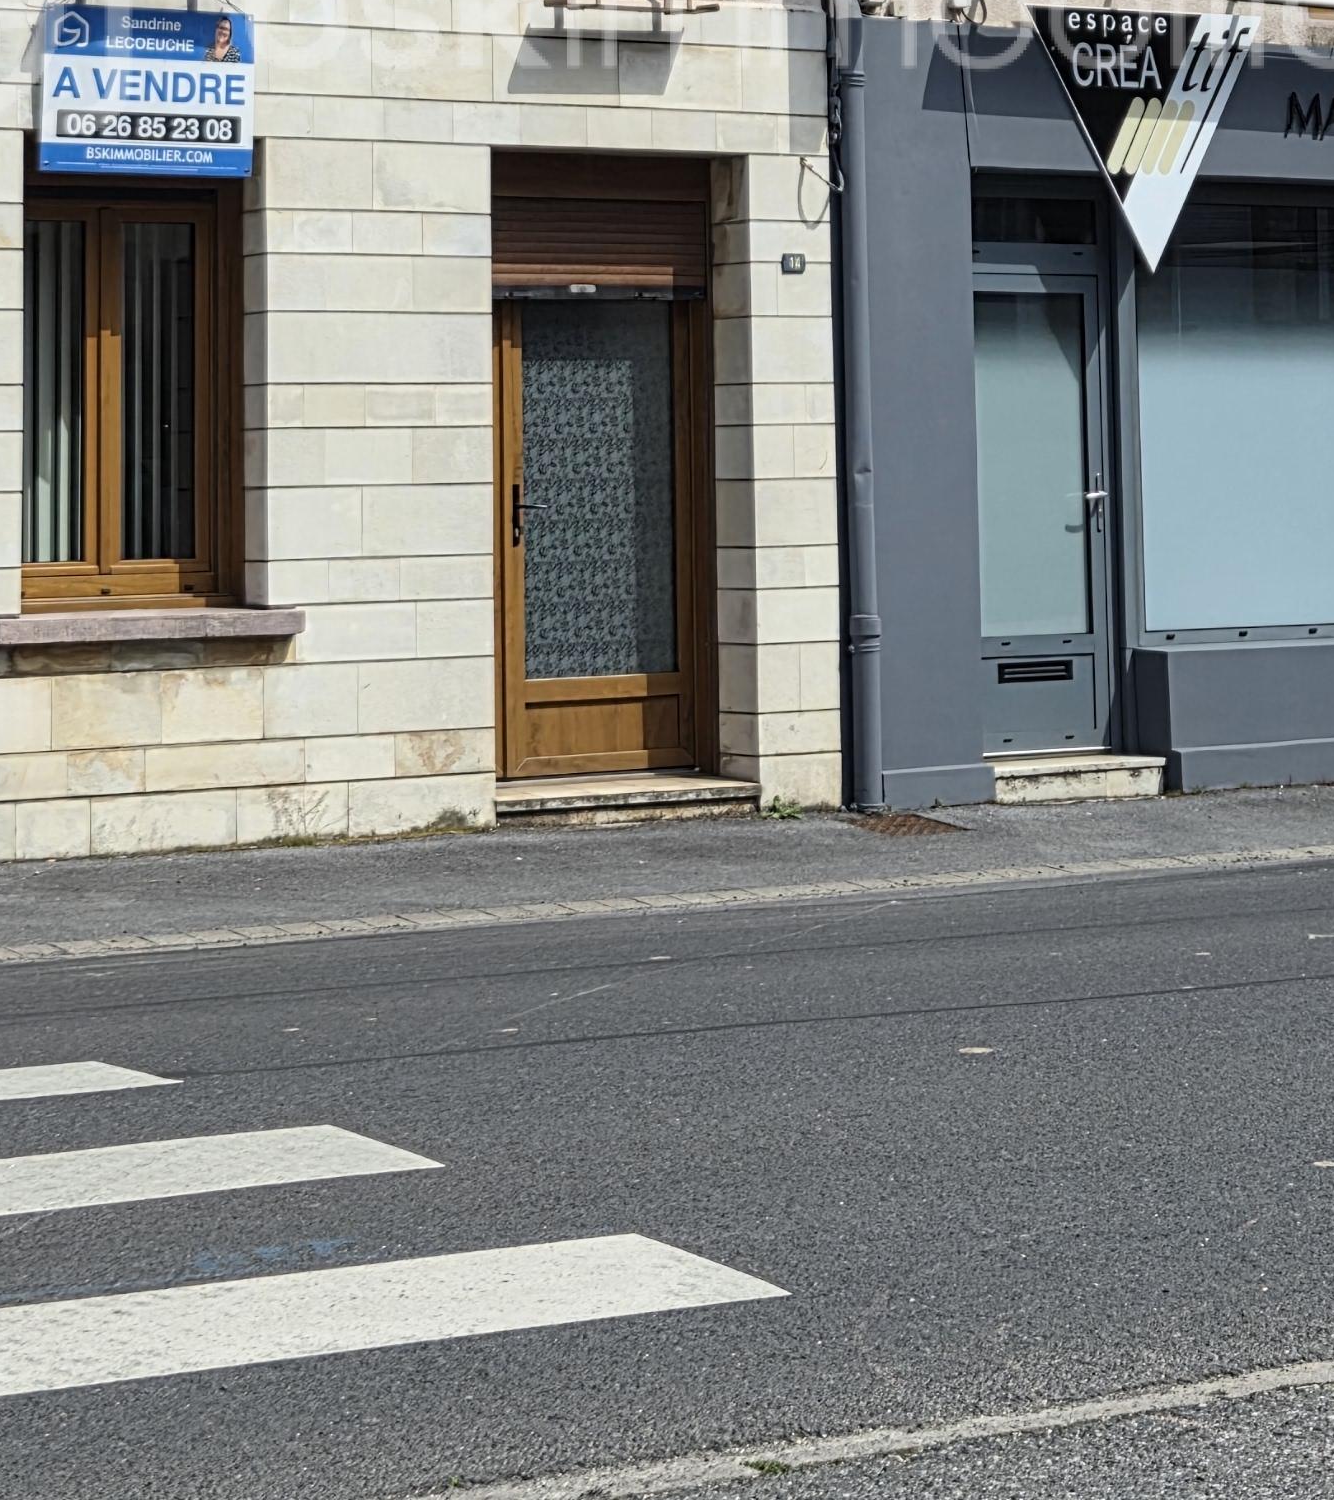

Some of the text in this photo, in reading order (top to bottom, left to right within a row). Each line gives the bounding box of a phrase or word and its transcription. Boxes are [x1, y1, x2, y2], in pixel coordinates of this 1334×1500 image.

[121, 15, 182, 32] Sandrine
[1068, 11, 1168, 37] espace
[105, 35, 195, 53] LECOEUCHE
[52, 66, 246, 106] A VENDRE
[67, 113, 233, 141] 06 26 85 23 08
[85, 146, 214, 164] BSKIMMOBILIER.COM
